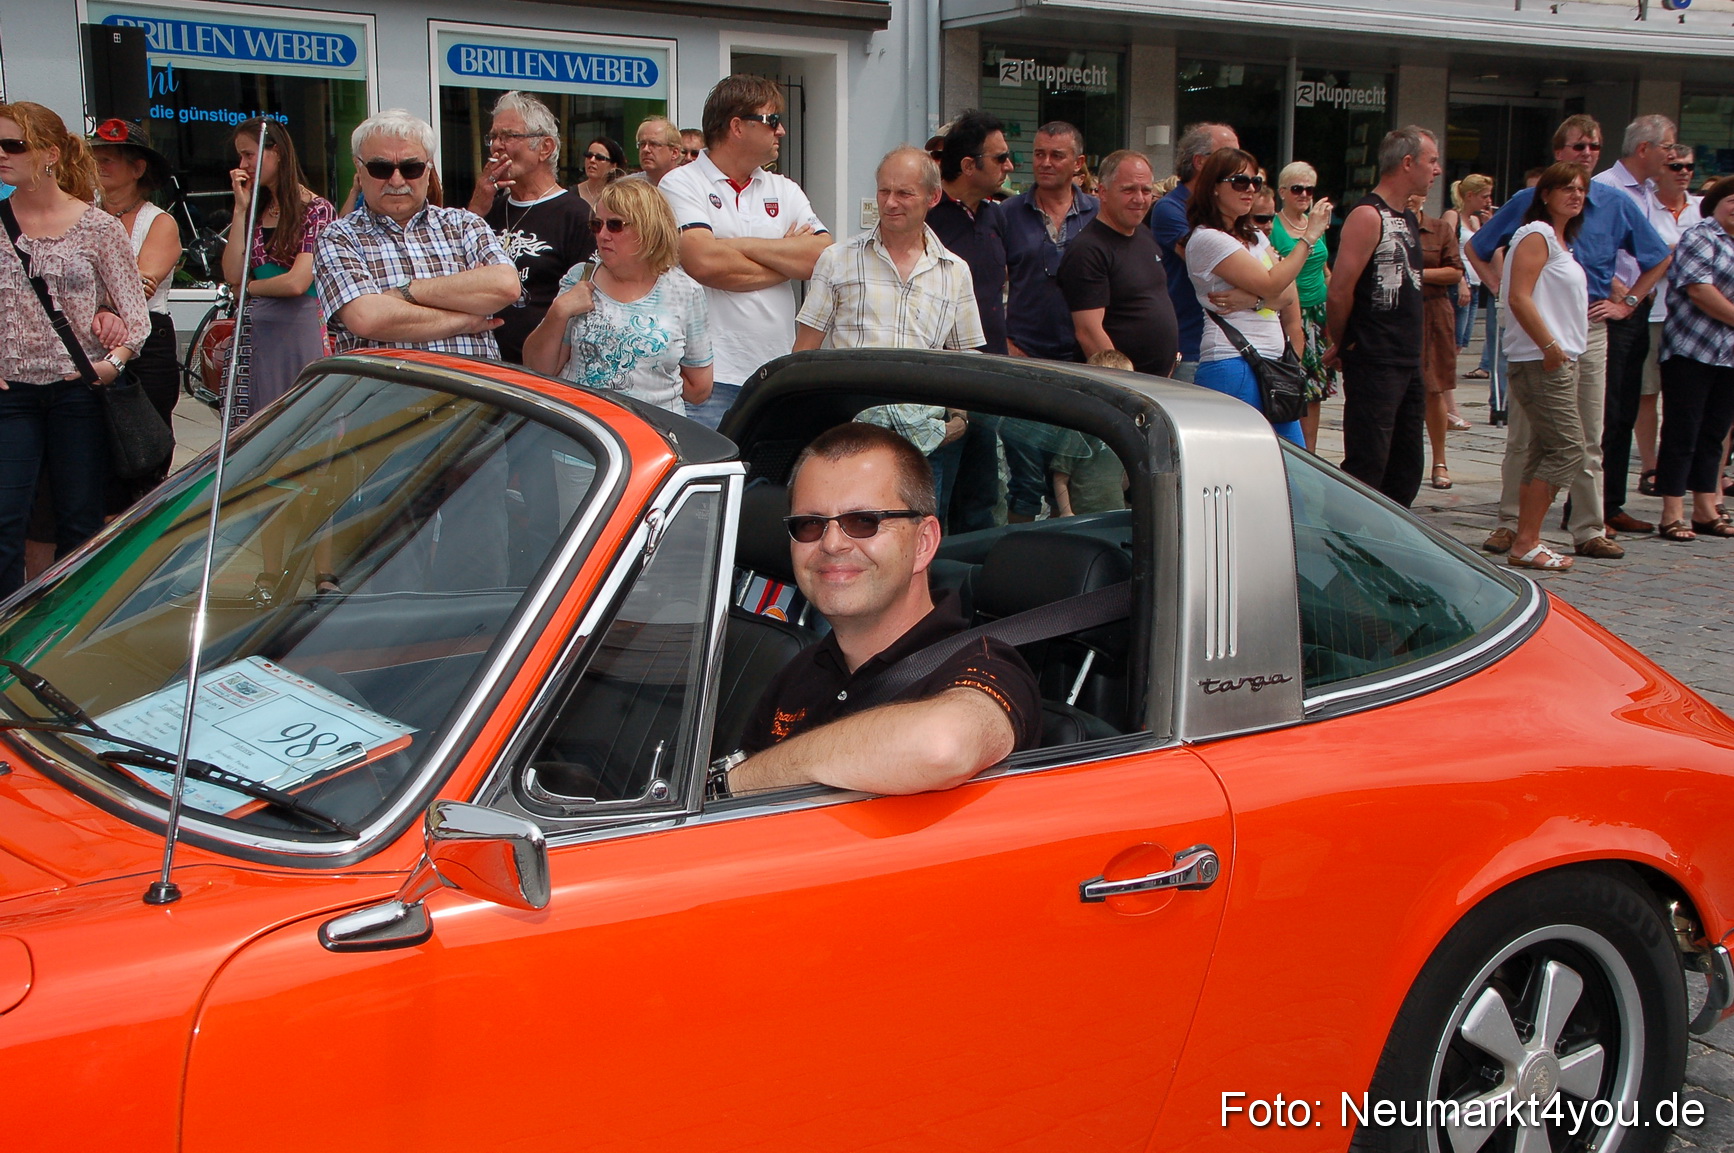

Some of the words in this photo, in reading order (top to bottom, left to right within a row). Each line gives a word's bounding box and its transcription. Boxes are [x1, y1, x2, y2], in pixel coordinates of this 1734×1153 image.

[243, 30, 347, 64] WEBER
[459, 46, 557, 79] BRILLEN
[564, 54, 648, 86] WEBER
[1023, 59, 1108, 90] Rupprecht
[1316, 82, 1386, 109] Rupprecht
[150, 104, 174, 119] die
[178, 106, 247, 126] günstige
[1199, 672, 1293, 695] targa
[257, 722, 339, 758] 98
